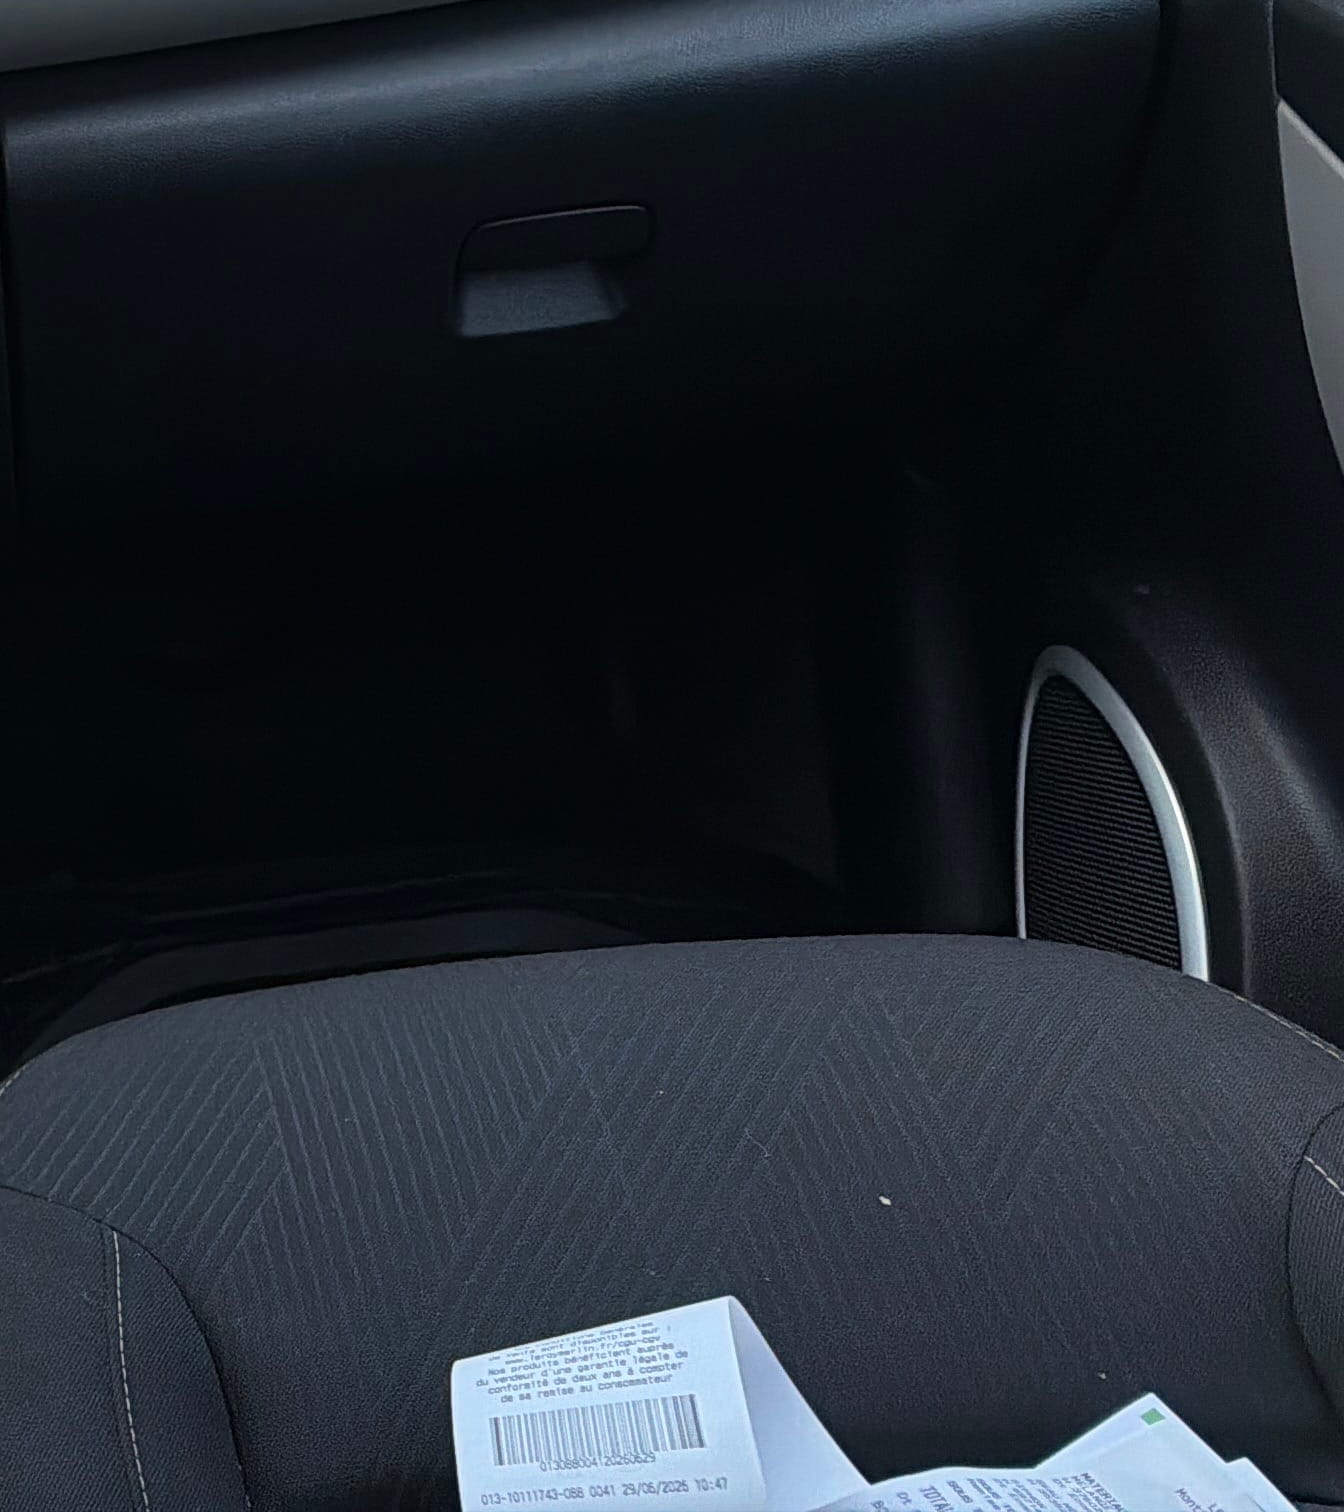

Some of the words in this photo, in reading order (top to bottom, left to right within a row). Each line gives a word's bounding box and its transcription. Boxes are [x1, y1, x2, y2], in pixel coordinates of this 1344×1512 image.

[476, 1379, 489, 1387] du
[494, 1372, 535, 1385] vendeur
[541, 1365, 572, 1377] d'une
[577, 1359, 627, 1373] garantie
[633, 1351, 670, 1365] légale
[675, 1349, 688, 1359] de
[488, 1368, 506, 1377] Nos
[511, 1360, 559, 1373] produits
[488, 1378, 549, 1395] conformité
[554, 1377, 567, 1386] de
[572, 1372, 597, 1383] deux
[603, 1369, 622, 1379] ans
[639, 1361, 684, 1374] compter
[501, 1394, 513, 1403] de
[519, 1392, 531, 1401] sa
[538, 1385, 574, 1398] remise
[580, 1384, 592, 1393] au
[694, 1476, 728, 1492] 10:47
